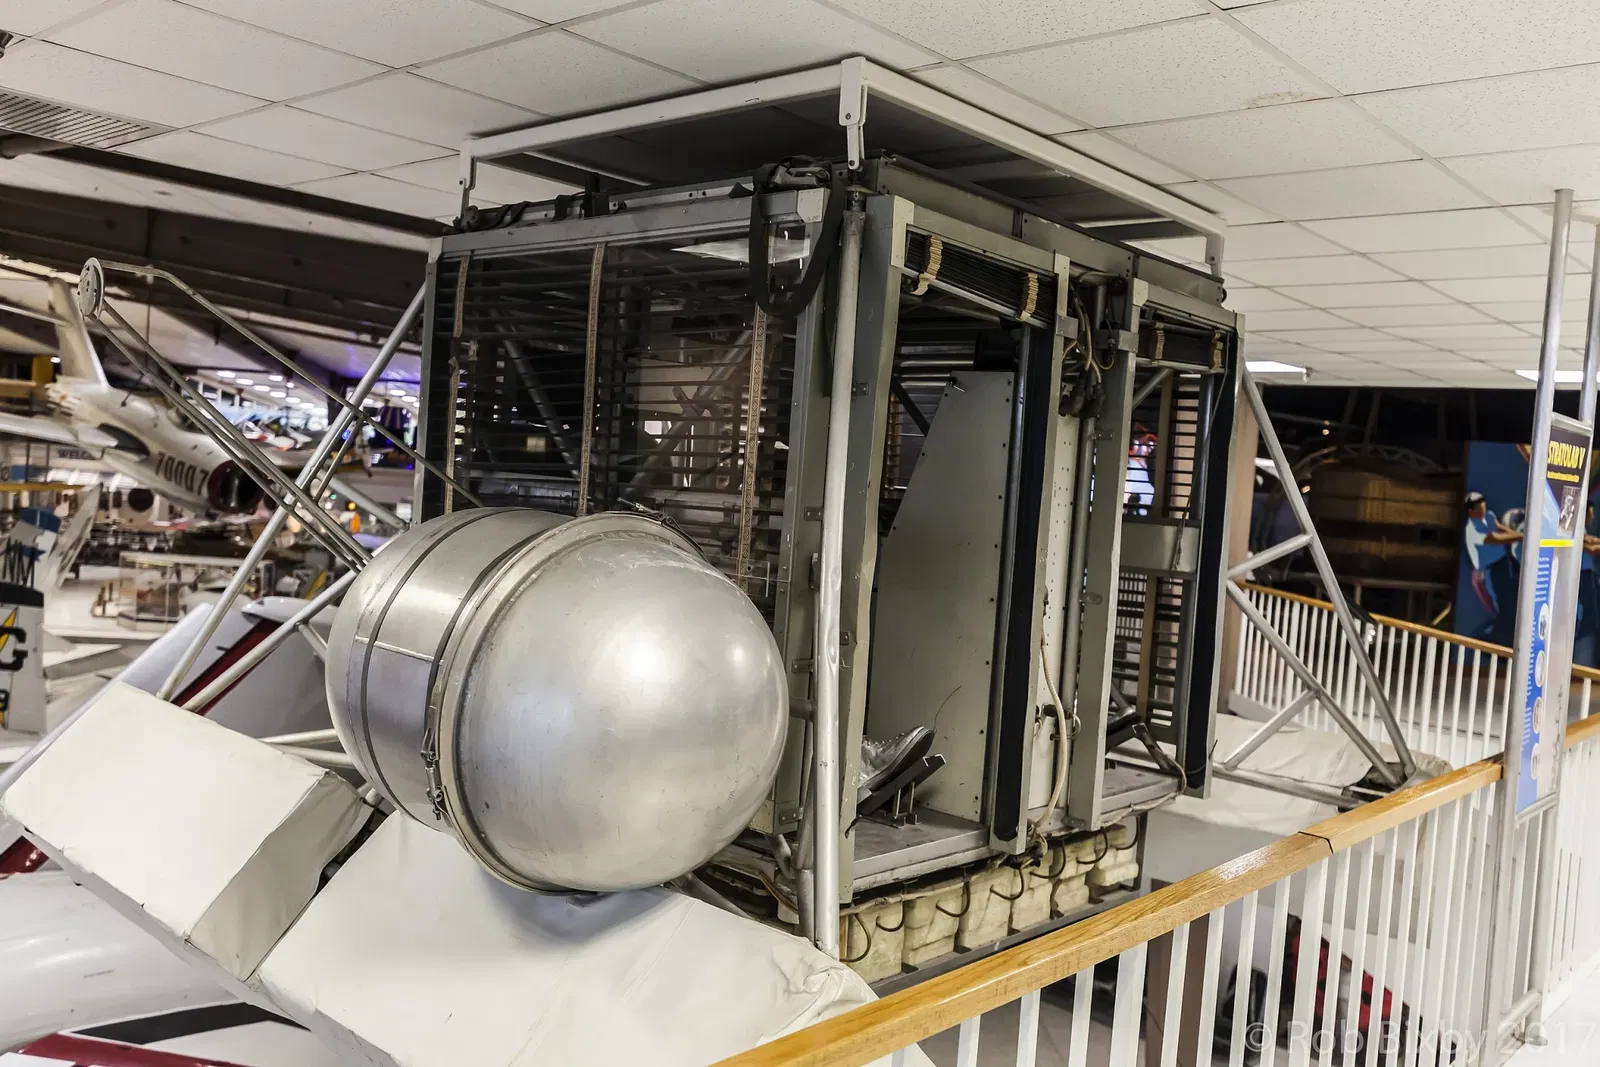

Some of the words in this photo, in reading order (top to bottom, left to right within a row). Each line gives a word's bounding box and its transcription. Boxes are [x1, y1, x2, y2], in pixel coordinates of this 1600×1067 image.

[1547, 440, 1580, 469] STRATOLAB
[1578, 446, 1586, 469] V
[155, 451, 210, 496] 70007
